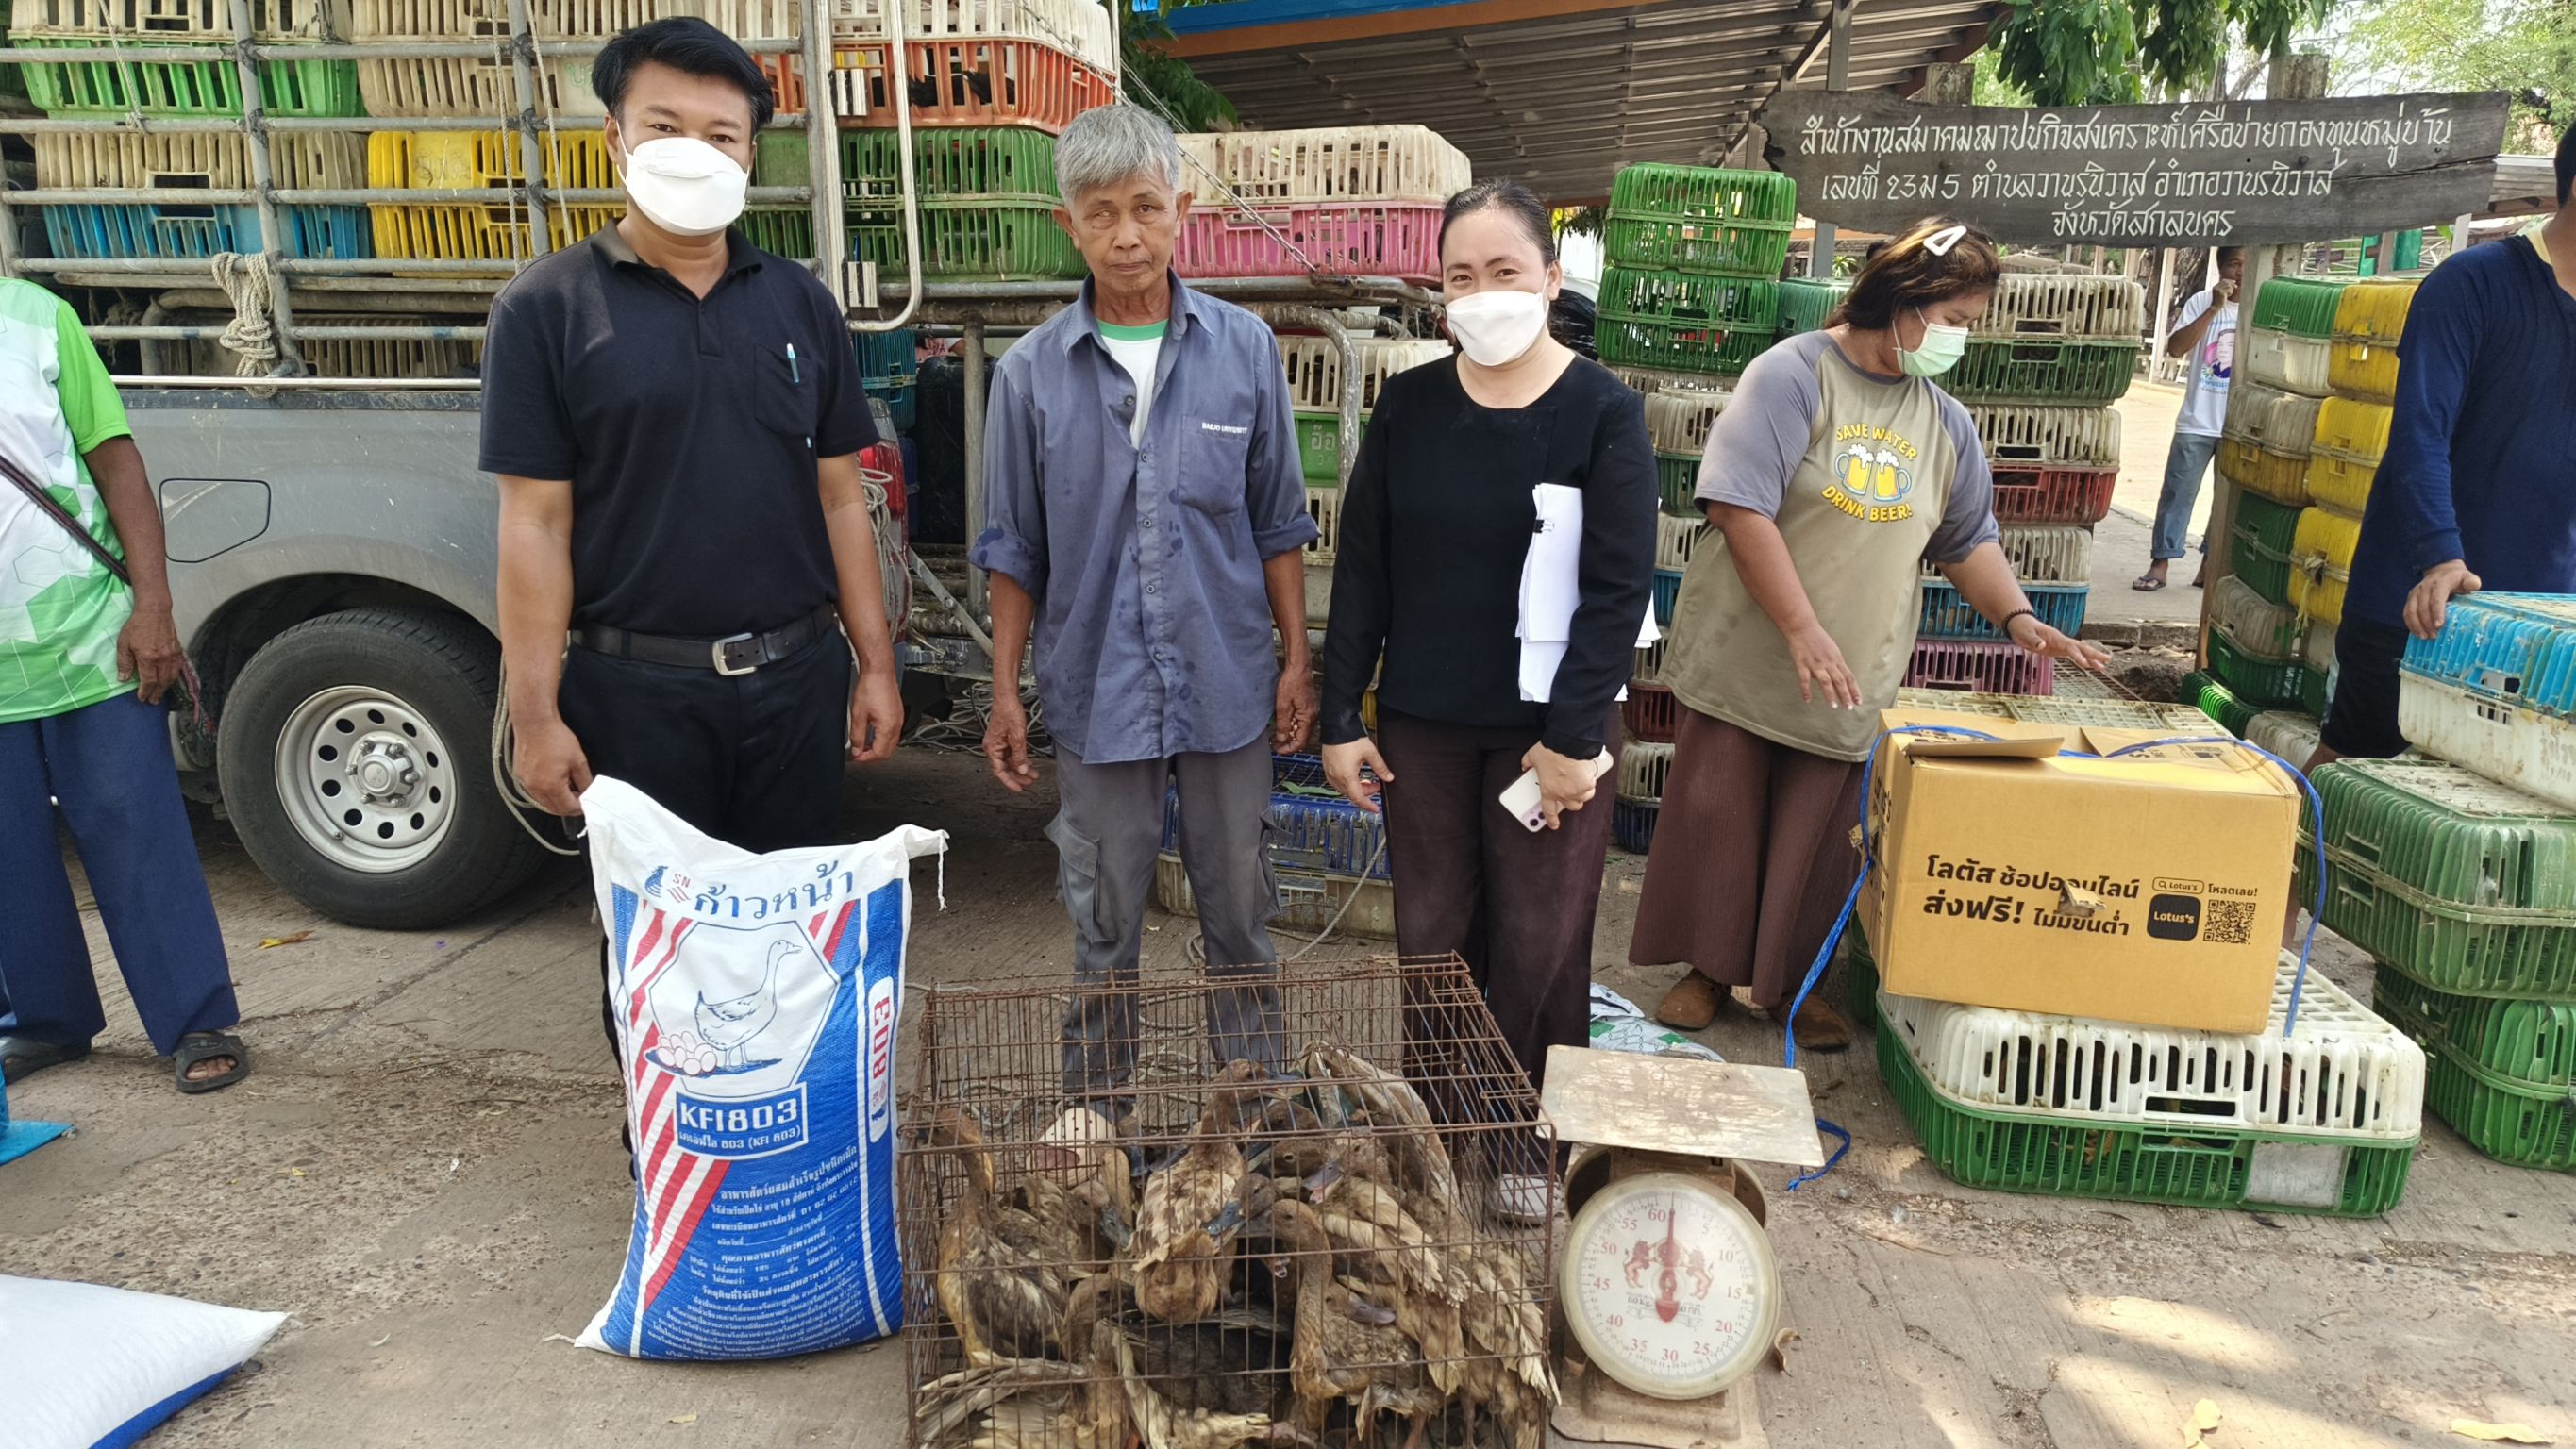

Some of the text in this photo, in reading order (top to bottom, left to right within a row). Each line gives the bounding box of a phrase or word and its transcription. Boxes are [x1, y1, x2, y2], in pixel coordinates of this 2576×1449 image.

[1822, 153, 1881, 200] เลขที่
[1971, 158, 2156, 199] ตำบลวานรนิวาส
[2155, 156, 2347, 197] อำเภอวานรนิวาส
[2051, 198, 2236, 237] จังหวัดสกลนคร
[1835, 423, 1917, 462] SAVE WATER
[1821, 484, 1913, 523] DRINK BEER!
[1926, 854, 1996, 884] โลตัส
[672, 874, 692, 888] SN
[2169, 882, 2198, 891] Lotus's
[694, 859, 854, 920] ก้าวหน้า
[2208, 883, 2258, 897] โหลดเลย!
[1923, 889, 2025, 924] ส่งฟรี!
[2153, 911, 2195, 924] Lotus's
[873, 996, 891, 1080] 803
[679, 1097, 798, 1133] KFI803
[721, 1139, 744, 1149] 803
[748, 1136, 770, 1151] (KFI
[773, 1124, 802, 1143] 803)
[1648, 1208, 1666, 1223] 60
[1621, 1217, 1638, 1230] 55
[1701, 1222, 1711, 1234] 5
[1600, 1241, 1616, 1255] 50
[1719, 1249, 1734, 1262] 10
[1594, 1277, 1610, 1291] 45
[1727, 1286, 1742, 1299] 15
[1606, 1314, 1623, 1328] 40
[1715, 1319, 1732, 1333] 20
[1630, 1338, 1648, 1352] 35
[1693, 1341, 1710, 1356] 25
[1661, 1348, 1679, 1362] 30
